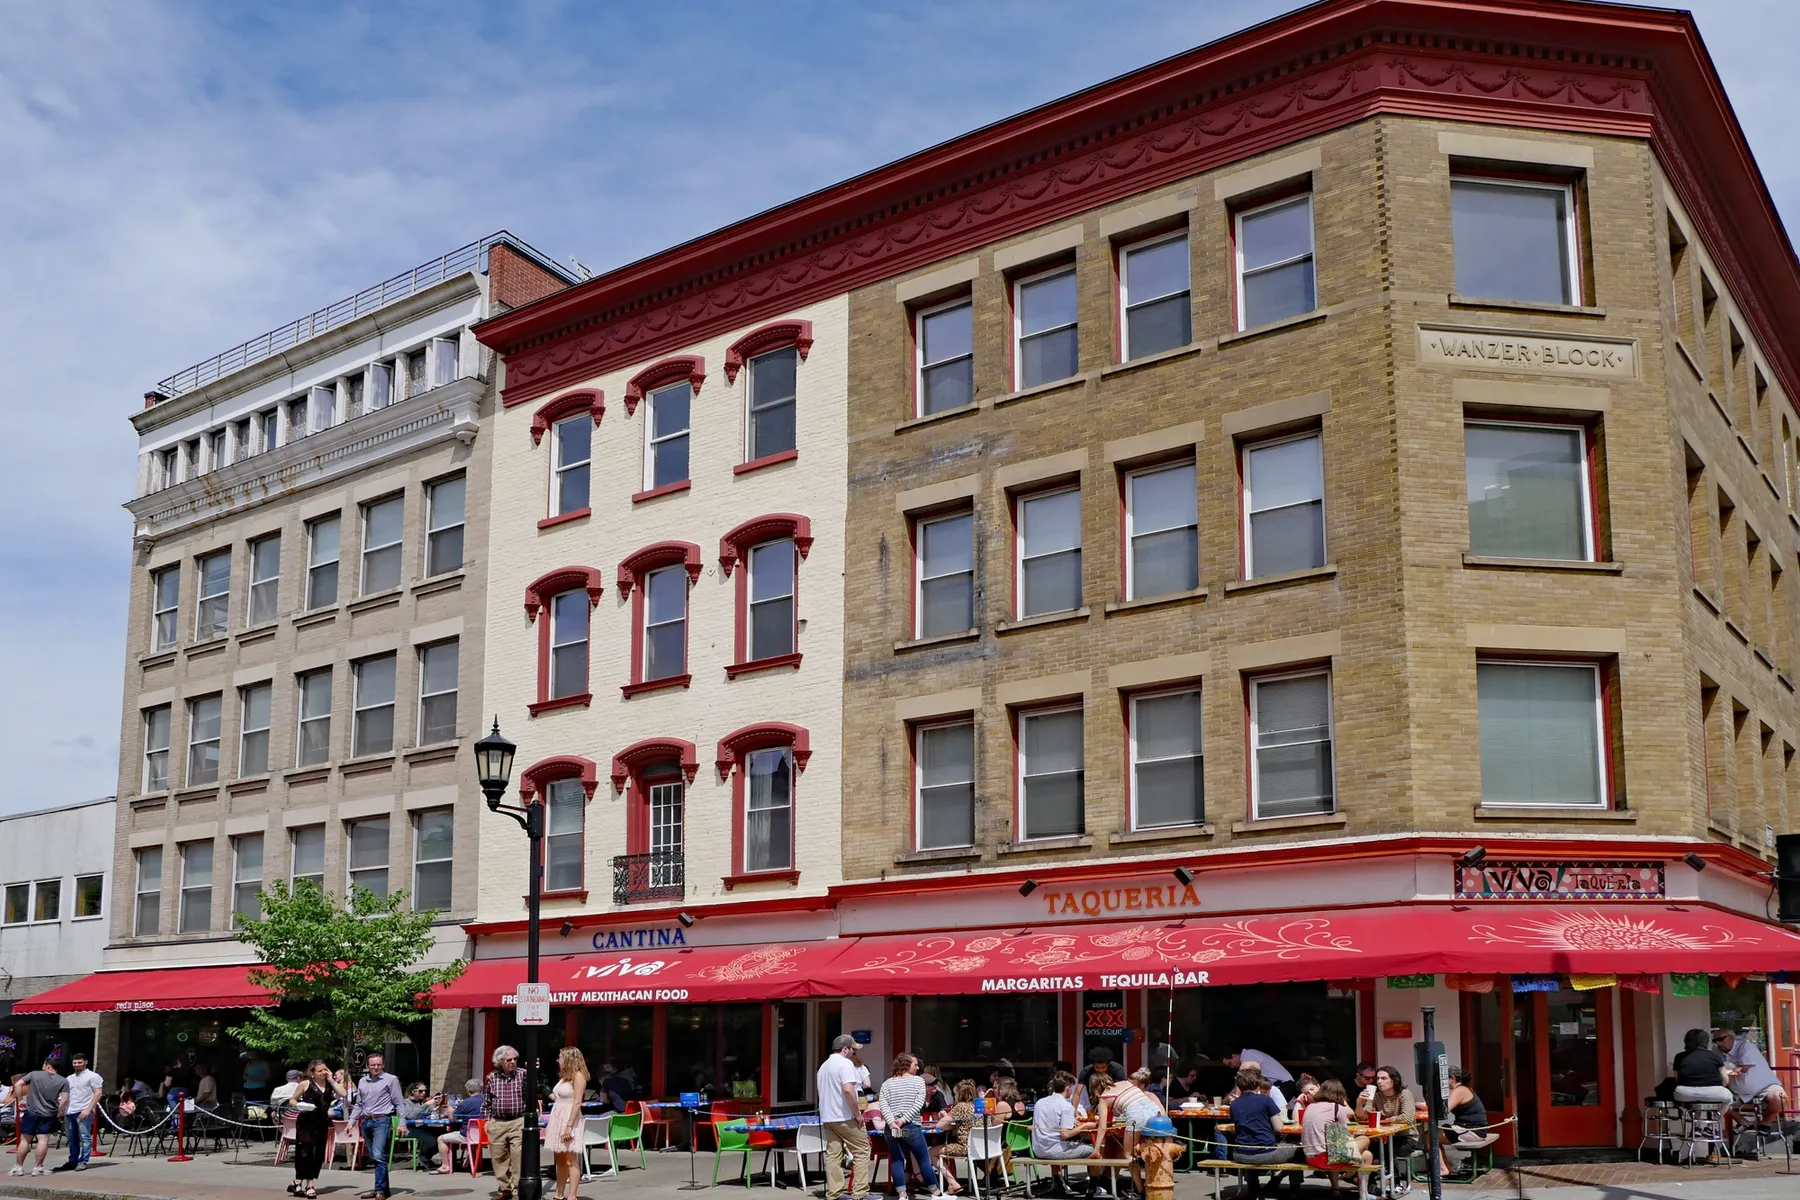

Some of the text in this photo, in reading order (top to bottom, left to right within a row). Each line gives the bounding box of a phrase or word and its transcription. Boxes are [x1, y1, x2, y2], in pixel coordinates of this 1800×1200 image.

[1439, 337, 1615, 368] WANZER BLOCK
[1043, 884, 1201, 916] TAQUERIA
[592, 927, 686, 949] CANTINA
[981, 970, 1209, 991] MARGARITAS TEQUILA BAR
[501, 989, 689, 1005] FRE ALTHY MEXITHACAN FOOD
[527, 986, 540, 995] NO
[134, 1000, 154, 1010] place
[1085, 1010, 1124, 1028] XX
[1084, 1028, 1101, 1036] DOS
